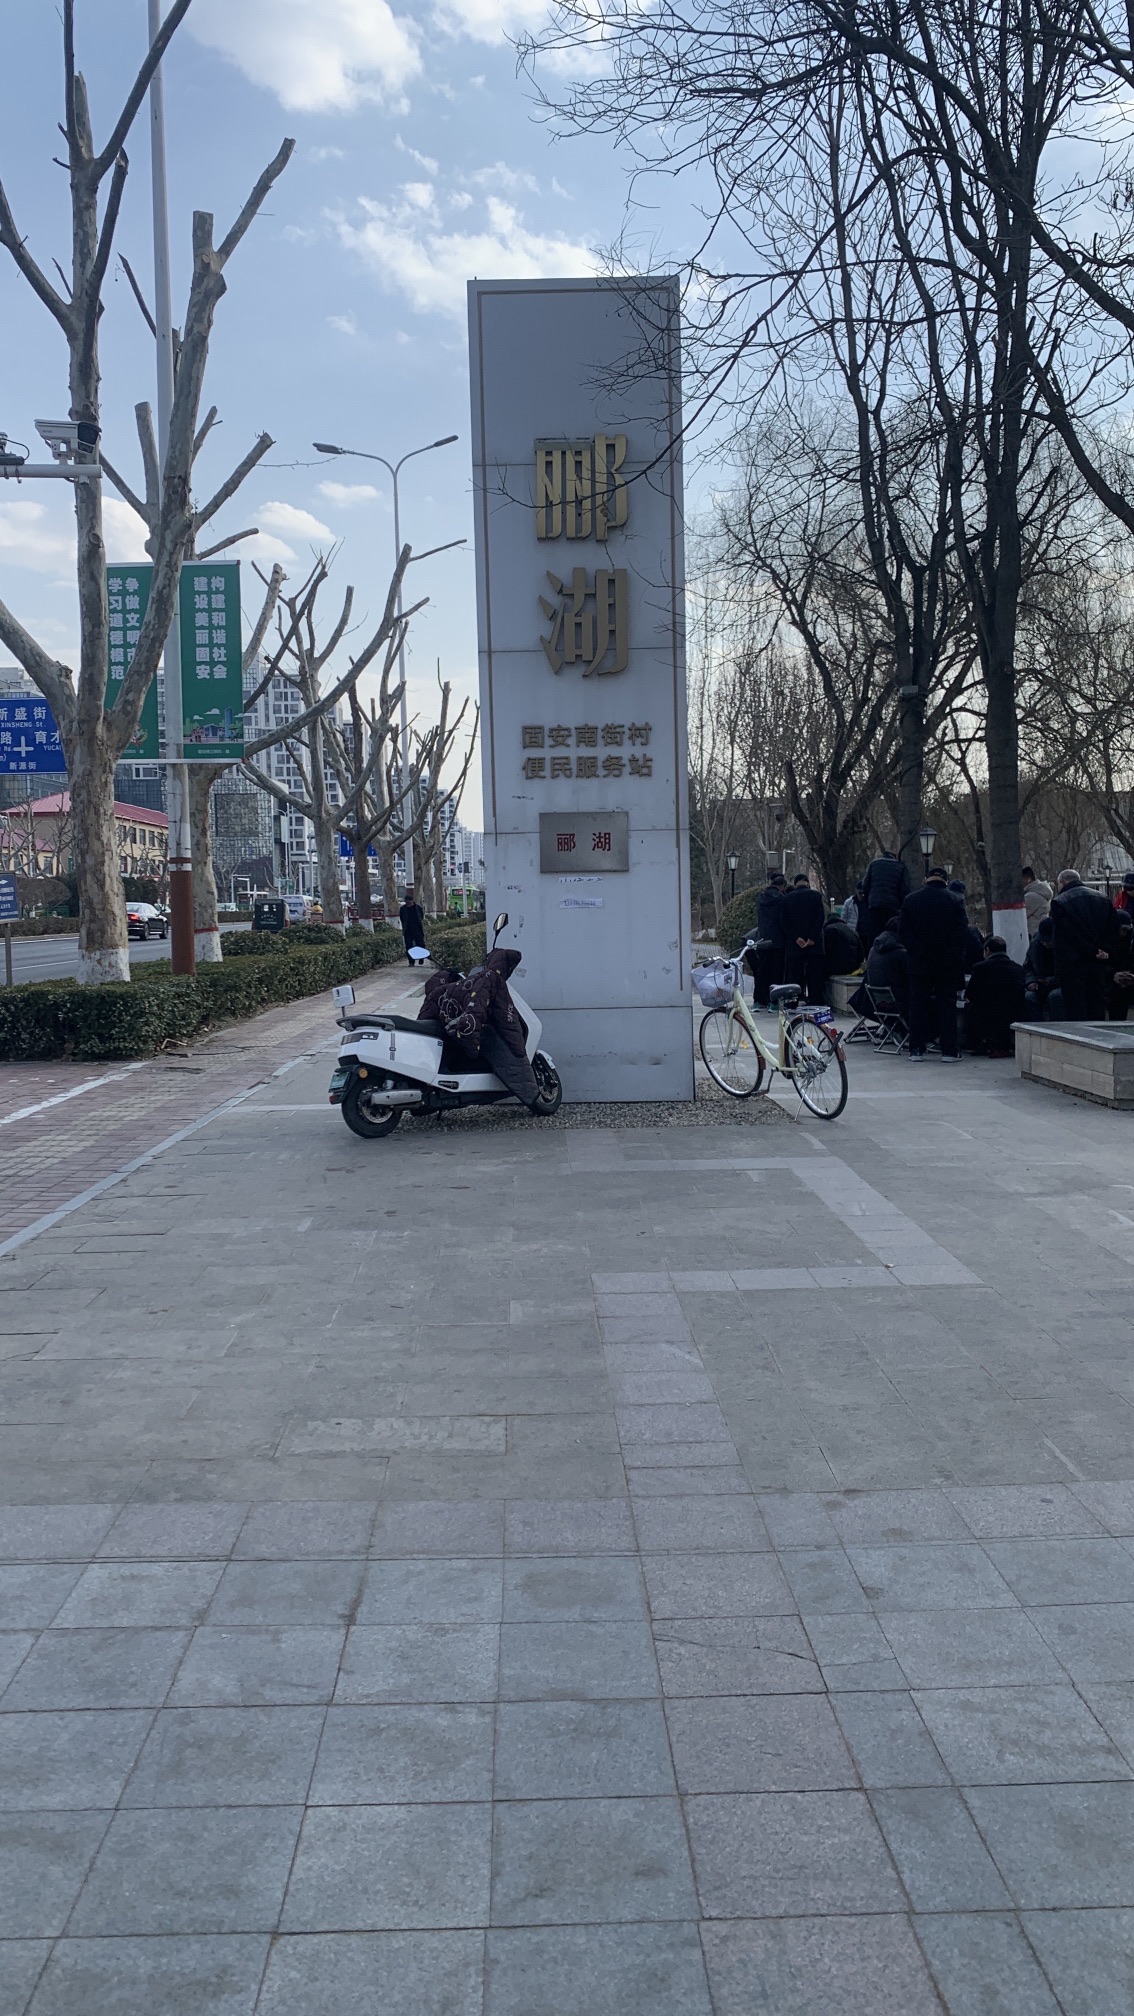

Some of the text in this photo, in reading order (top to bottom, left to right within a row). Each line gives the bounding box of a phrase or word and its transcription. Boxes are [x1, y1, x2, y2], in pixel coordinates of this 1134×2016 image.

[535, 433, 628, 678] 郦湖
[109, 577, 125, 680] 学习道德模范
[194, 576, 210, 679] 建设美丽固安
[211, 576, 227, 679] 构建和谐社会
[521, 721, 653, 749] 固安南街村
[521, 753, 654, 780] 便民服务站
